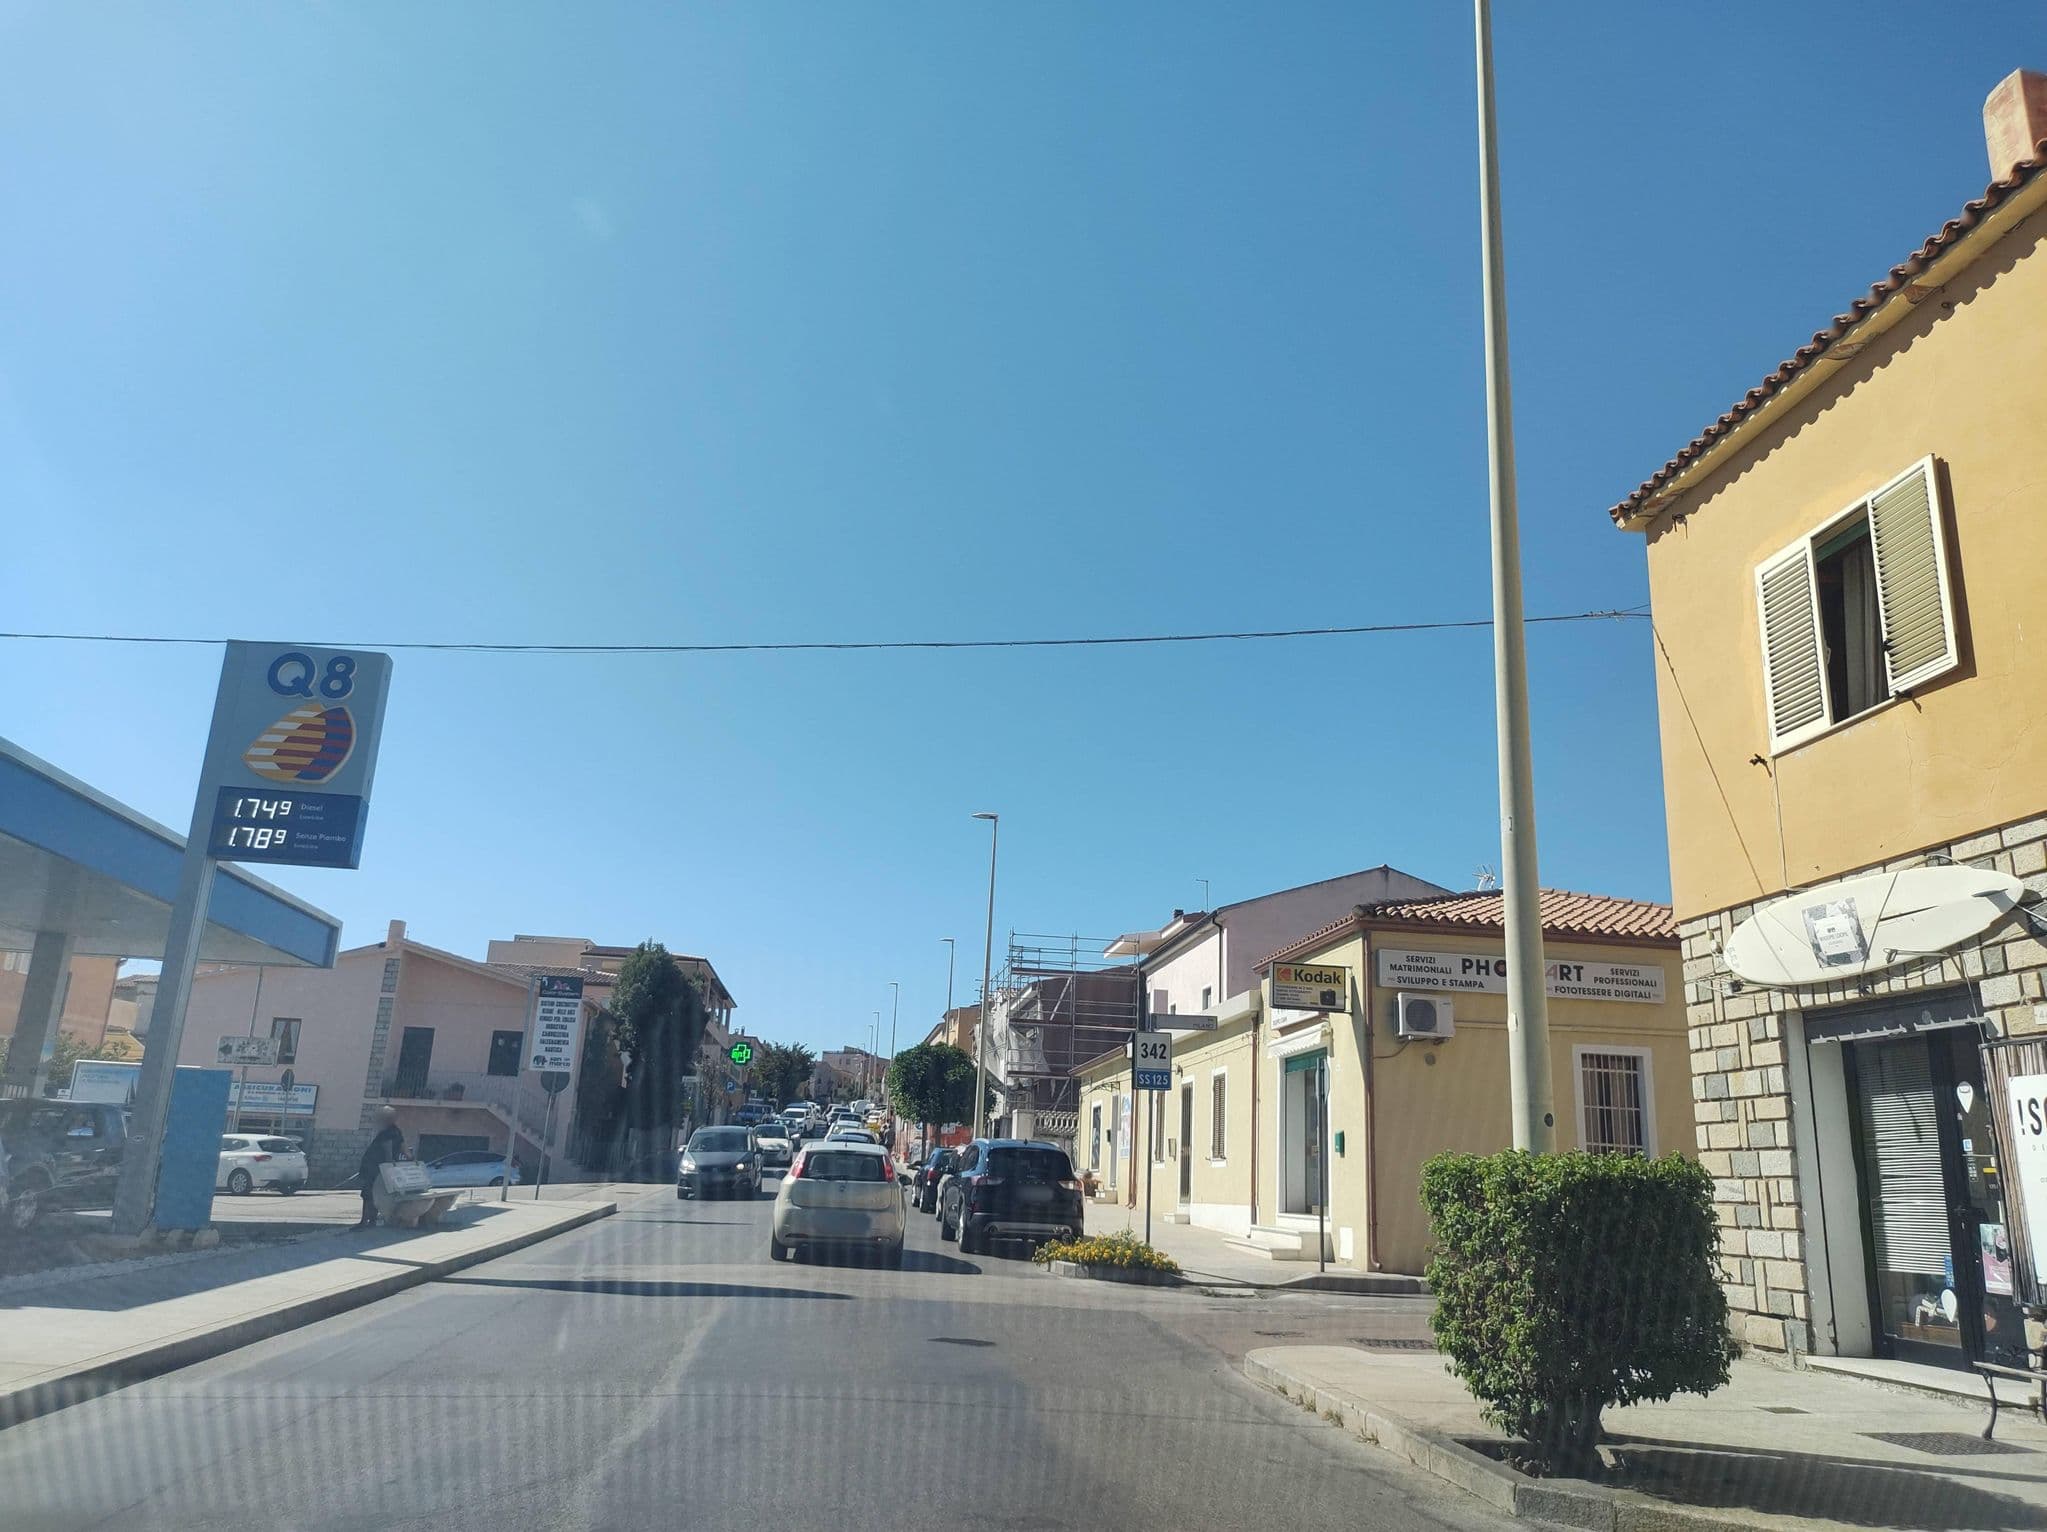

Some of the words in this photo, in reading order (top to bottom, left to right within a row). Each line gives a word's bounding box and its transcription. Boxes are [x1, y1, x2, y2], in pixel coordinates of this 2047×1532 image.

[267, 652, 358, 700] Q8
[300, 803, 324, 812] Diesel
[1405, 955, 1436, 964] SERVIZI
[1389, 964, 1452, 975] MATRIMONIALI
[1610, 968, 1640, 977] SERVIZI
[1294, 969, 1342, 984] Kodak
[1396, 976, 1439, 986] SVILUPPO
[1449, 980, 1485, 989] STAMPA
[1593, 976, 1657, 988] PROFESSIONALI
[1554, 986, 1612, 997] FOTOTESSERE
[1614, 989, 1652, 999] DIGITALI
[1140, 1042, 1167, 1060] 342
[1138, 1074, 1151, 1085] SS
[1152, 1074, 1169, 1085] 125
